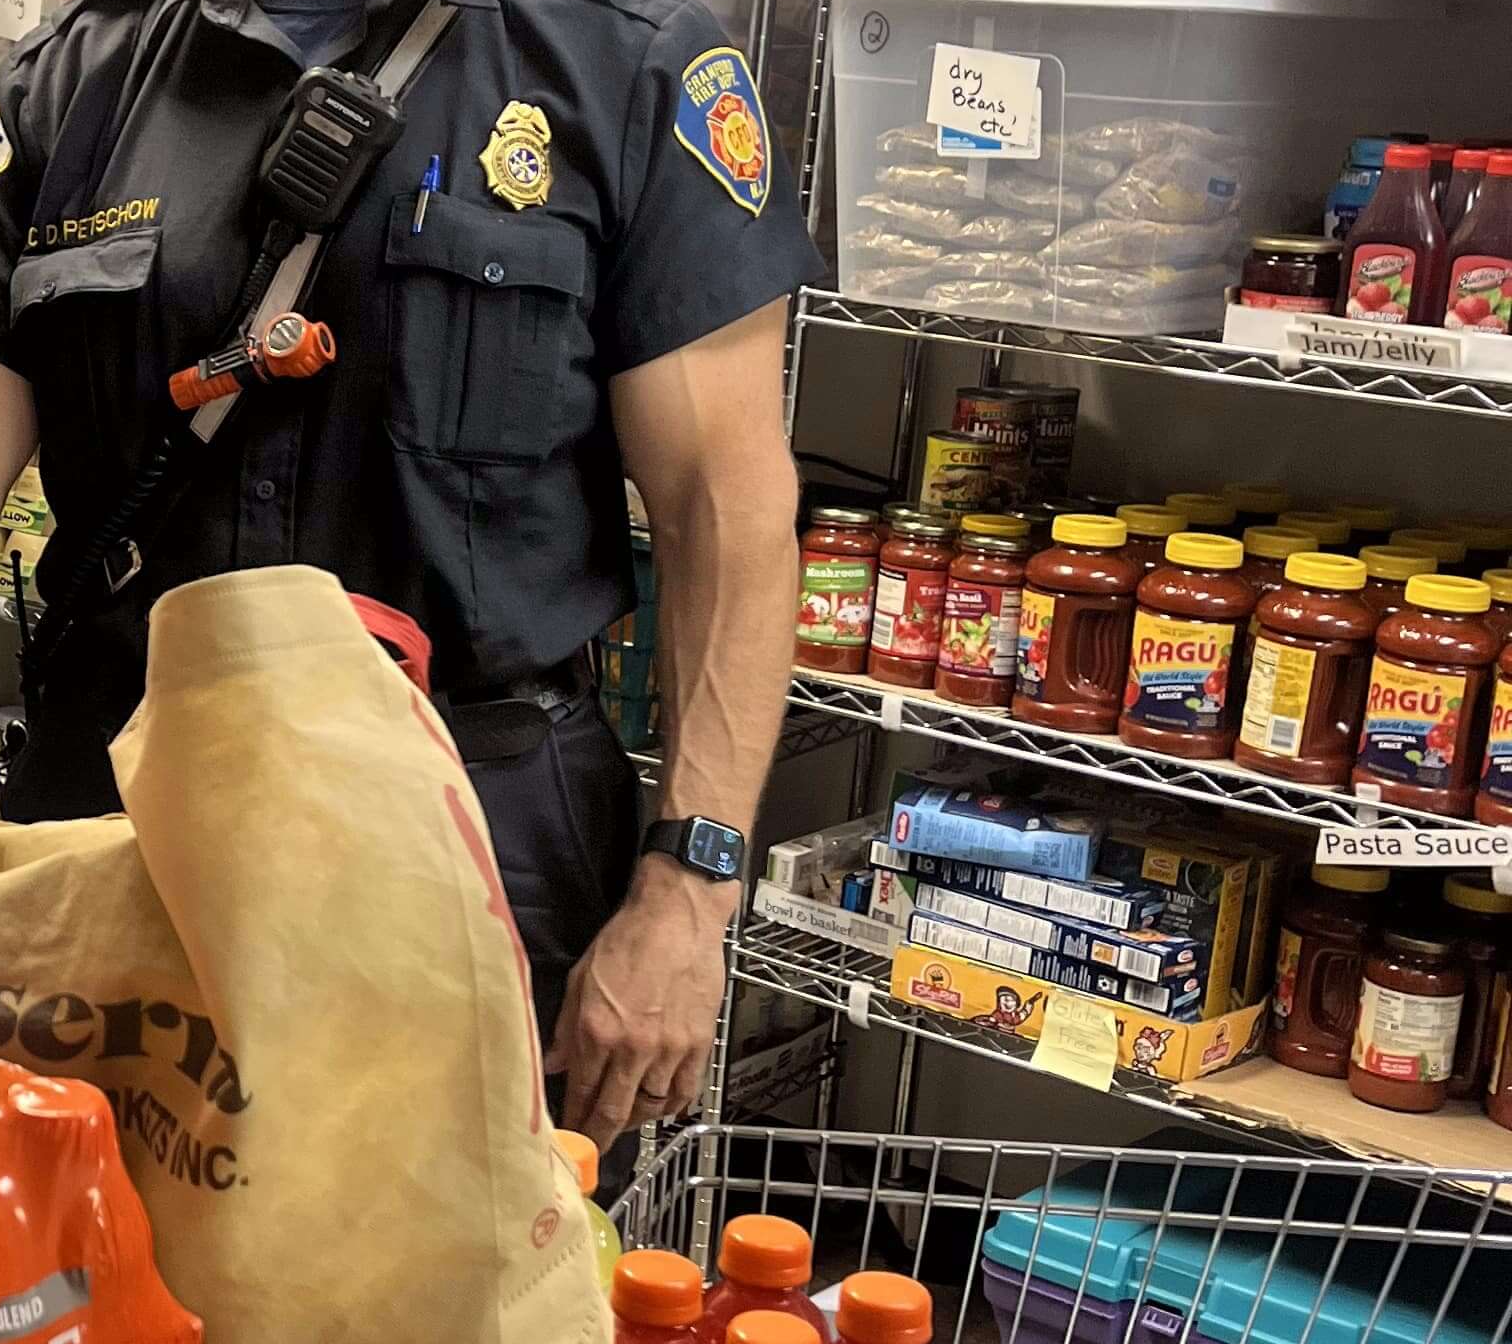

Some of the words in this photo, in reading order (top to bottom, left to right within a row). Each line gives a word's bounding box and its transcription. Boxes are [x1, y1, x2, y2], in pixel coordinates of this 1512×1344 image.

[867, 17, 883, 43] 2
[949, 56, 983, 96] dry
[690, 80, 719, 107] FIRE
[63, 197, 161, 241] PETSCHOW
[1301, 334, 1436, 365] Jam/Jelly
[806, 566, 865, 579] Mushroom
[1139, 635, 1217, 666] RAGÚ
[1146, 684, 1197, 696] TRADITIONAL
[1156, 692, 1183, 700] SAUCE
[1368, 682, 1443, 716] RAGÚ
[1327, 833, 1402, 857] Pasta
[1414, 833, 1509, 857] Sauce
[765, 901, 794, 920] bowl
[796, 909, 809, 923] &
[809, 911, 852, 937] basket
[1058, 1029, 1098, 1054] Free
[159, 1136, 251, 1194] INC.
